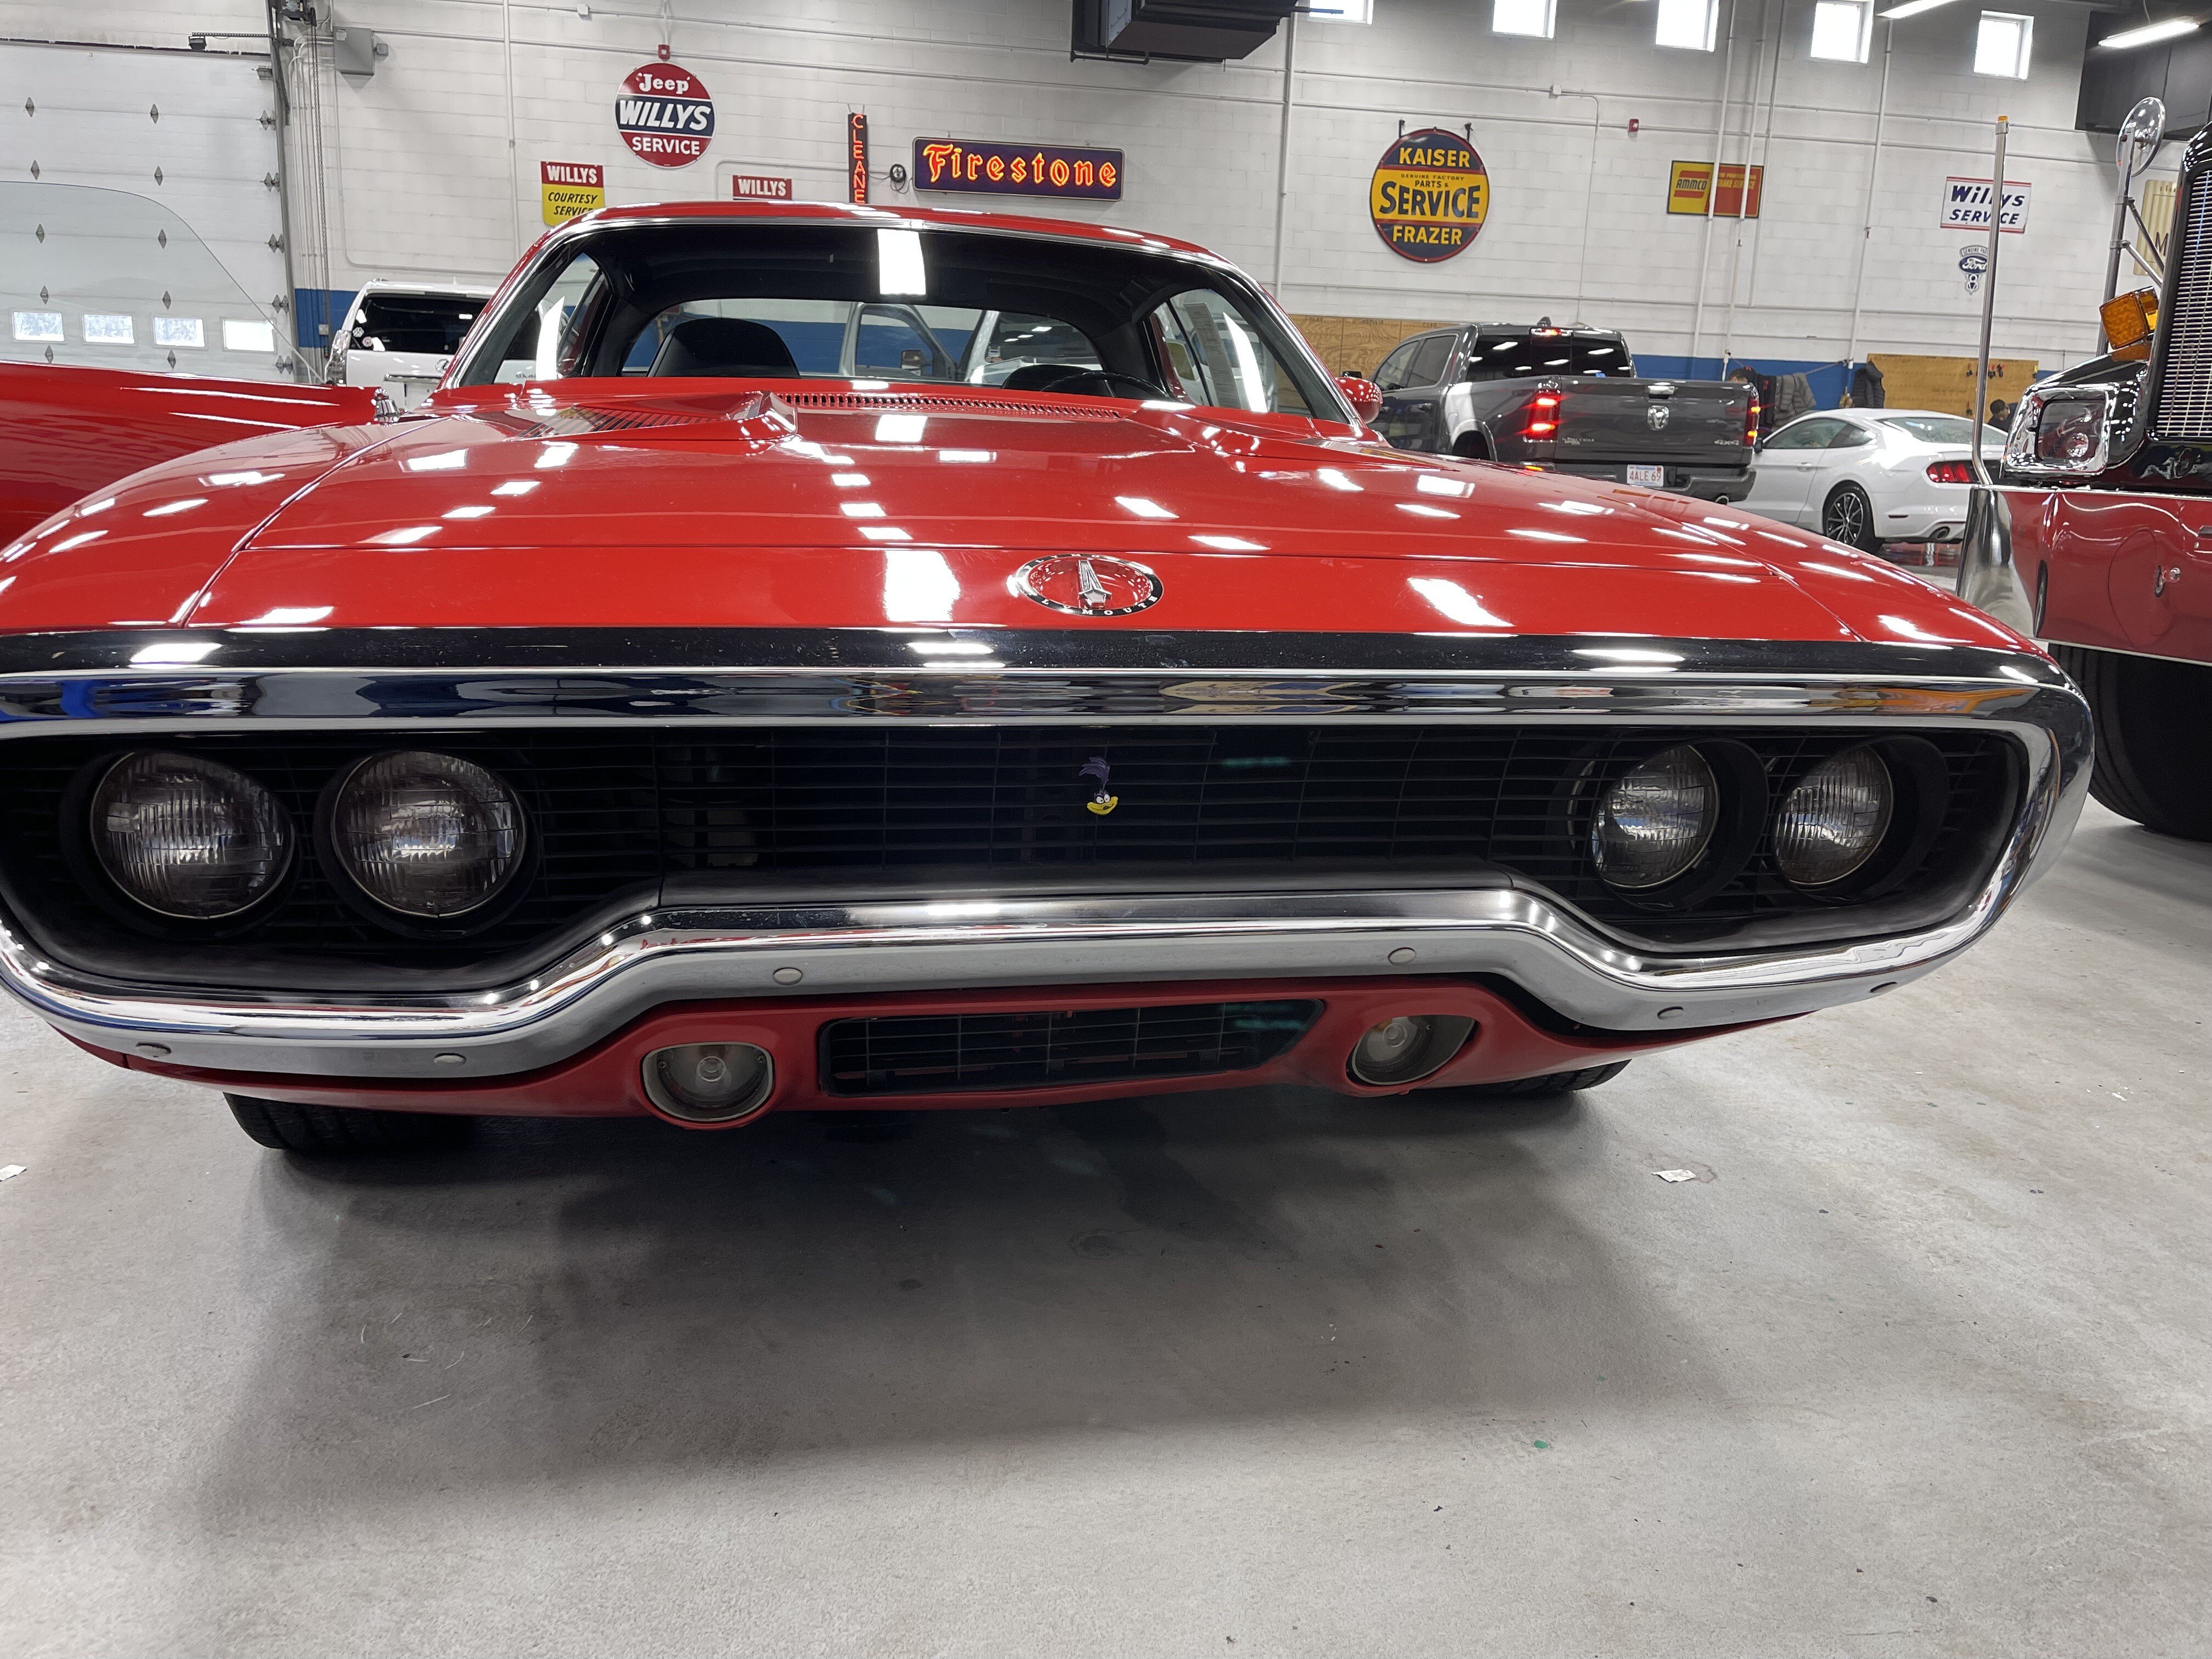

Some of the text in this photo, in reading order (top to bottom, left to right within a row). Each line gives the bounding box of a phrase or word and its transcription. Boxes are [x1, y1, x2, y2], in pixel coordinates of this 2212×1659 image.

[620, 100, 711, 131] WILLYS
[632, 137, 699, 155] SERVICE
[923, 144, 1116, 187] Firestone
[1399, 147, 1470, 167] KAISER
[547, 165, 597, 184] WILLYS
[738, 178, 786, 196] WILLYS
[1951, 185, 2024, 208] Wilys
[548, 191, 598, 204] COURTESY
[1379, 180, 1480, 218] SERVICE
[1949, 209, 2019, 224] SERVCE
[1393, 225, 1462, 245] FRAZER
